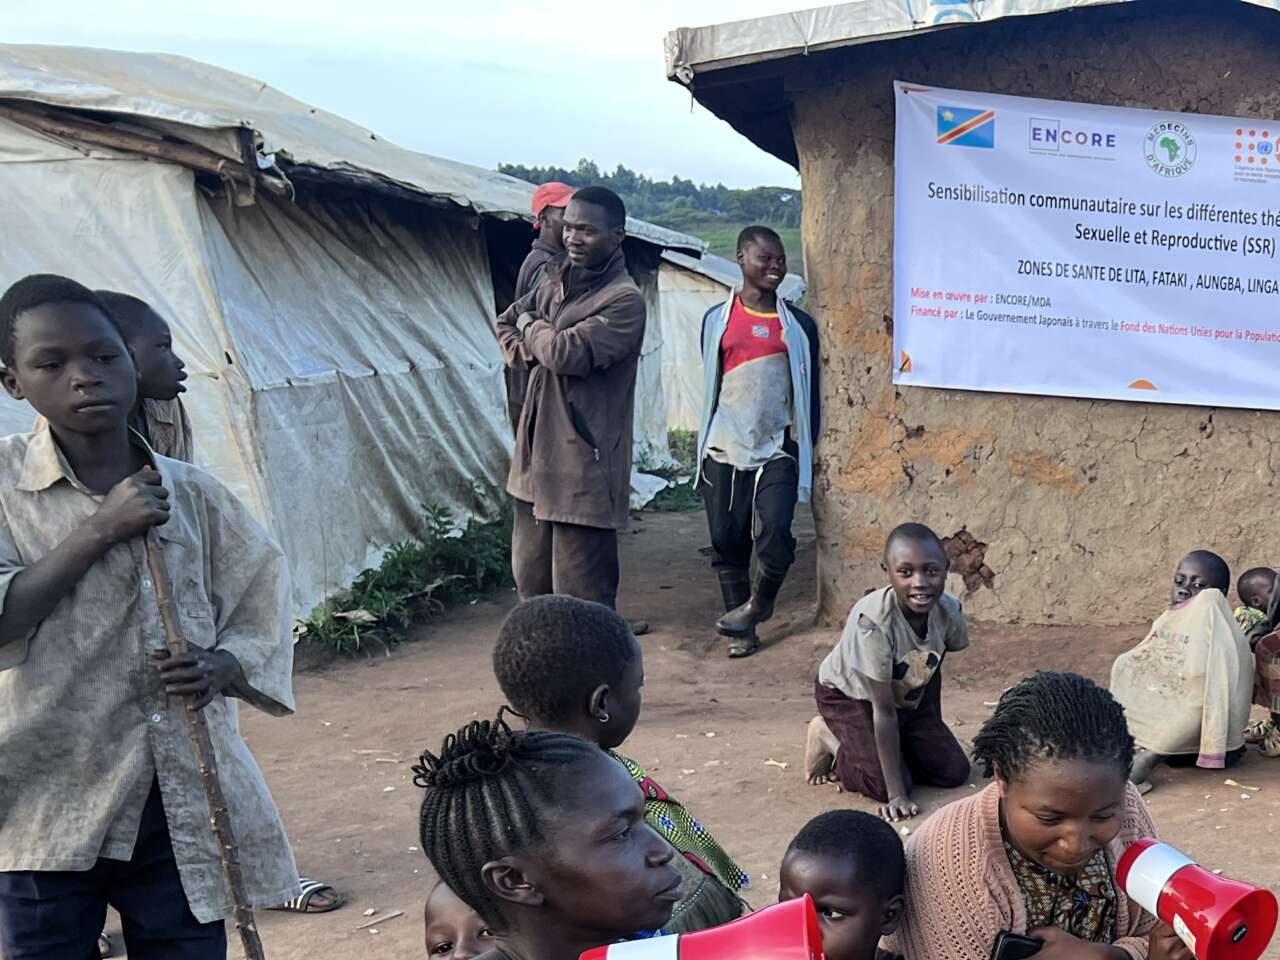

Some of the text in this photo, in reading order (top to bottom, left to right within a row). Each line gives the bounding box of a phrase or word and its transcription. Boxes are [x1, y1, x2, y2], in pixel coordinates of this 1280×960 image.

[1032, 127, 1116, 148] ENCORE
[1146, 153, 1193, 178] D'AFRIQUE
[928, 182, 1026, 207] Sensibilisation
[1029, 194, 1137, 216] communautaire
[1139, 203, 1162, 218] sur
[1164, 201, 1184, 220] les
[1186, 203, 1258, 226] différentes
[1075, 223, 1276, 259] Sexuelle et Reproductive (SSR)
[1017, 260, 1054, 278] ZONES
[1055, 263, 1070, 279] DE
[1072, 264, 1107, 282] SANTE
[1108, 267, 1123, 283] DE
[1125, 268, 1150, 288] LITA,
[1152, 270, 1188, 288] FATAKI
[1195, 274, 1245, 296] AUNGBA,
[1247, 278, 1280, 295] LINGA
[911, 288, 931, 299] Mise
[933, 291, 944, 304] en
[945, 293, 972, 303] œuvre
[974, 294, 988, 305] par
[995, 293, 1052, 310] ENCORE/MDA
[911, 305, 942, 319] Financé
[944, 310, 959, 321] par
[965, 308, 975, 321] Le
[976, 309, 1037, 325] Gouvernement
[1038, 314, 1074, 328] Japonais
[1082, 319, 1109, 331] travers
[1111, 319, 1119, 331] le
[1120, 320, 1140, 333] Fond
[1142, 322, 1156, 334] des
[1158, 323, 1188, 336] Nations
[1190, 326, 1213, 338] Unies
[1214, 330, 1233, 341] pour
[1235, 330, 1243, 340] la
